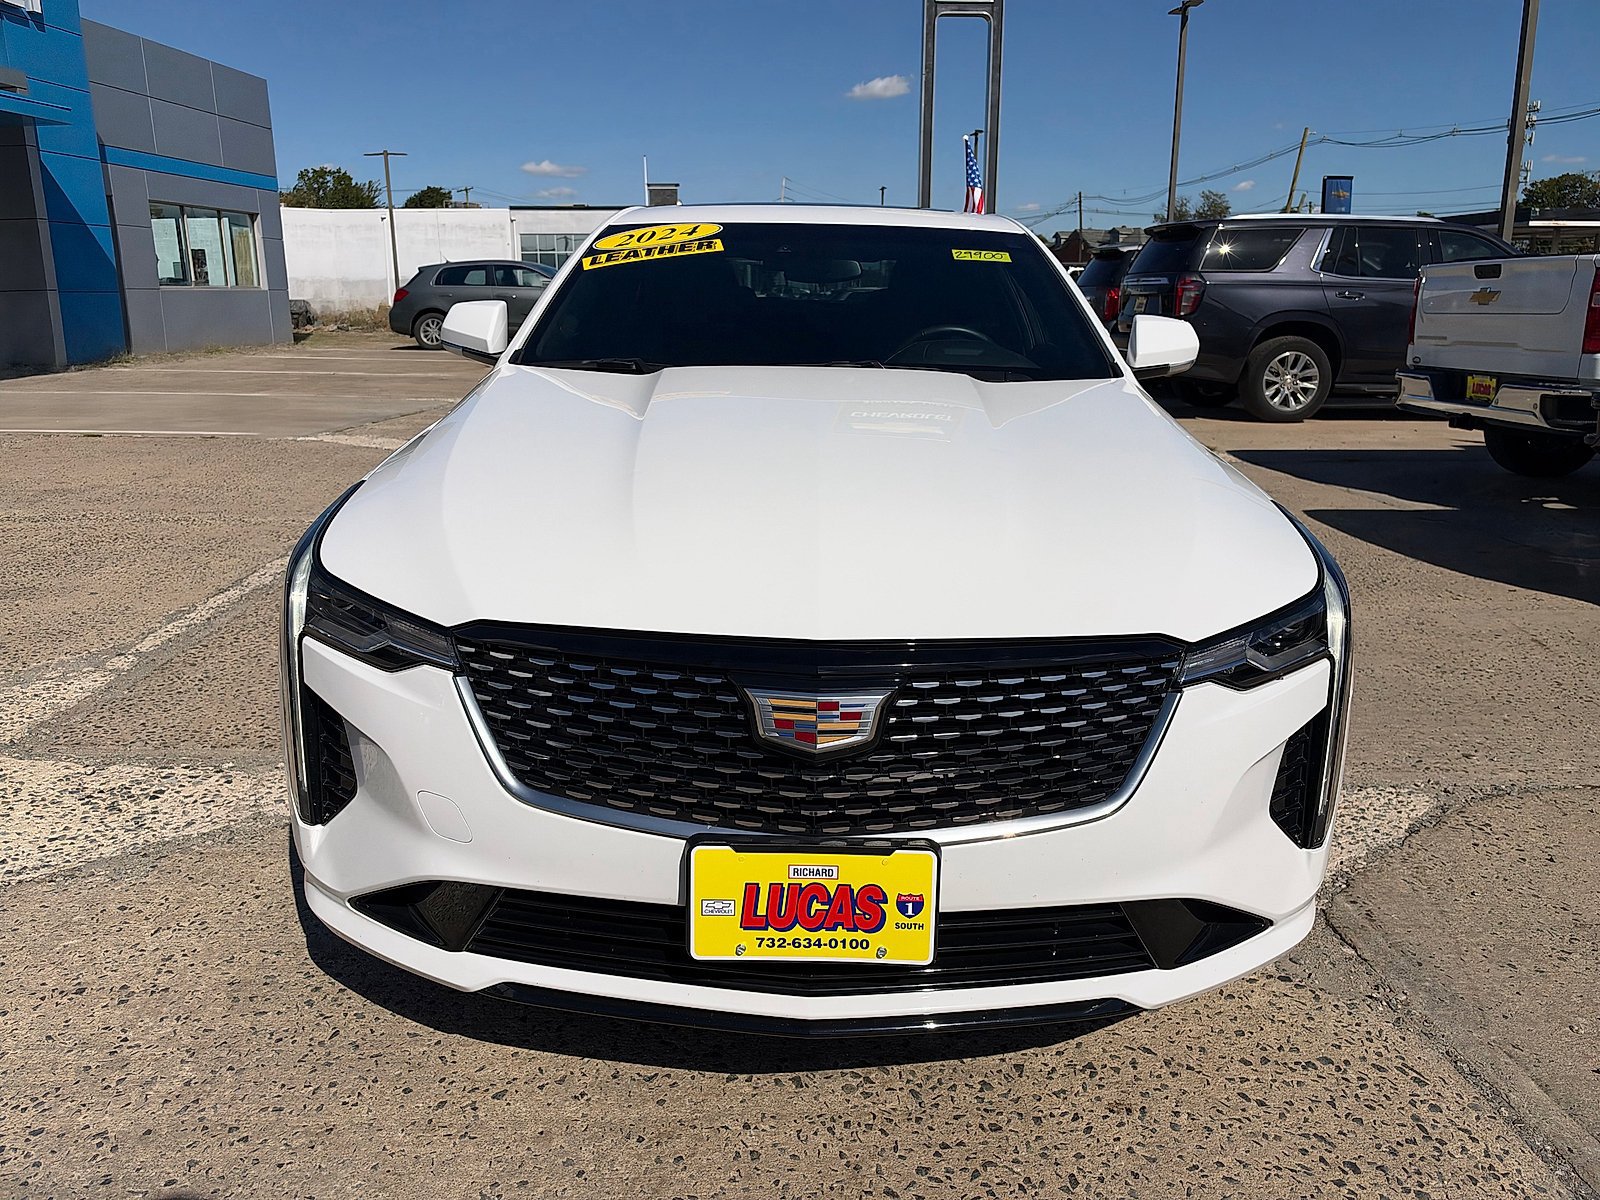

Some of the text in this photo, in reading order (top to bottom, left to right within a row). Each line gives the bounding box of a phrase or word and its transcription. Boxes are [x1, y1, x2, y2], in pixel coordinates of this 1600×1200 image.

[614, 224, 701, 247] 2024
[588, 240, 717, 266] LEATHER
[792, 867, 834, 878] RICHARD
[740, 882, 888, 933] LUCAS
[905, 902, 915, 915] 1
[894, 922, 924, 930] SOUTH
[755, 937, 870, 949] 732-634-0100
